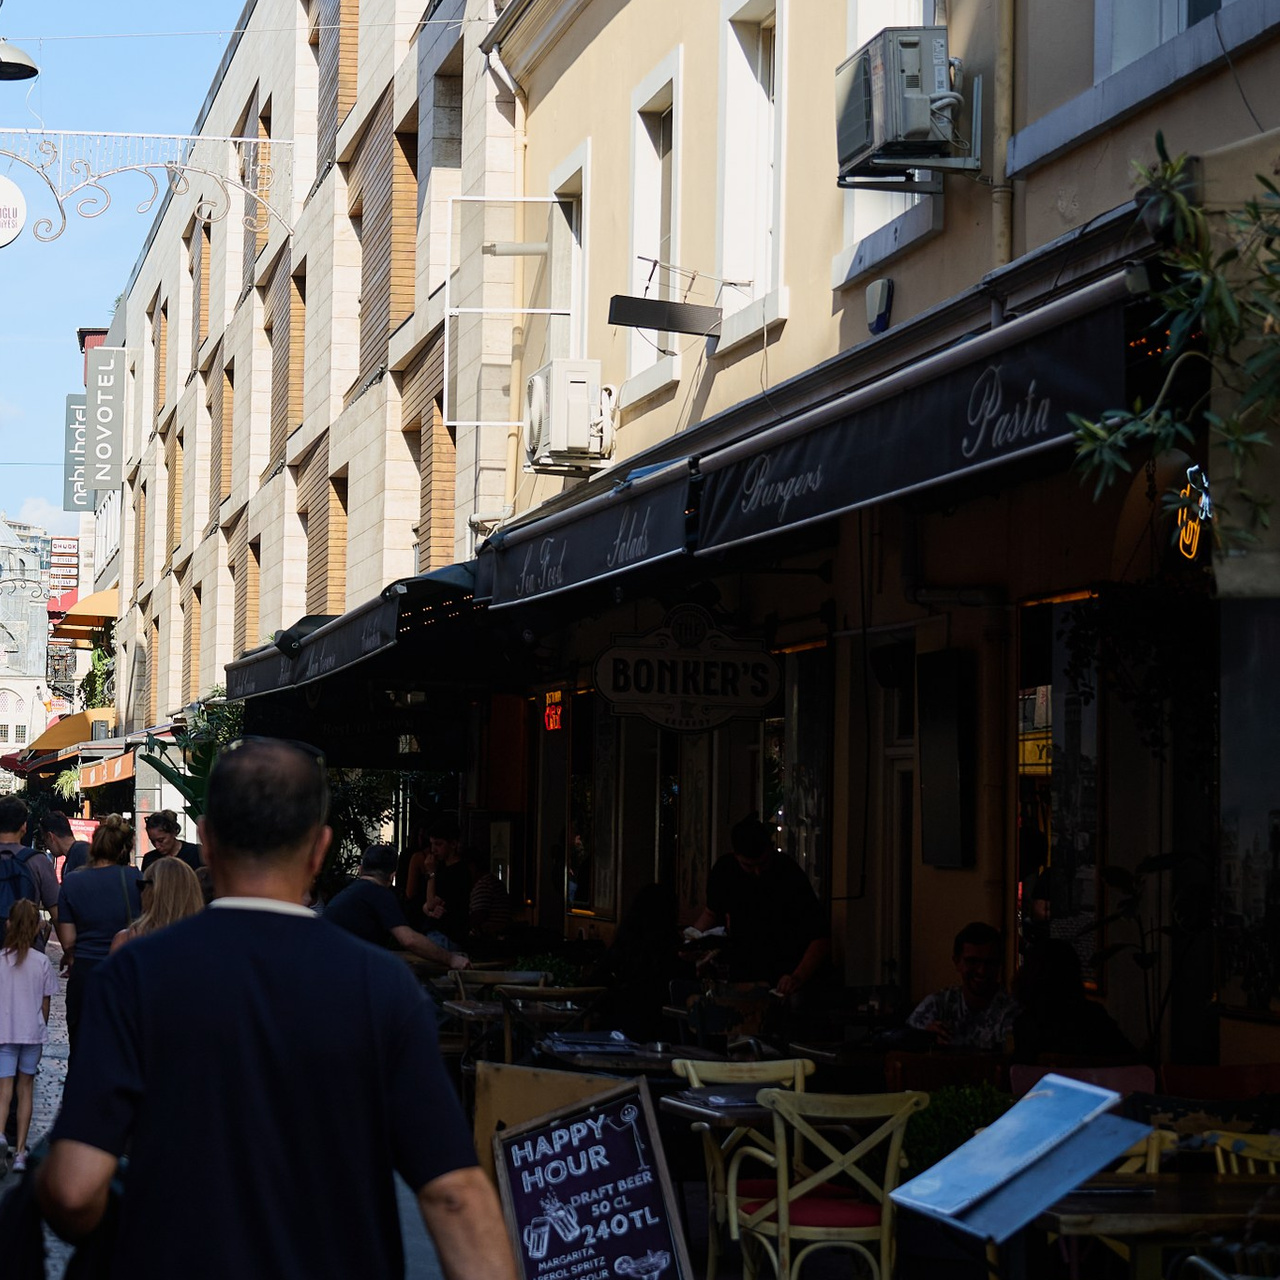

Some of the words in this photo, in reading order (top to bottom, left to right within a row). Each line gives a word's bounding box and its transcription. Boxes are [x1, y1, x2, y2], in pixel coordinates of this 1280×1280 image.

[95, 358, 114, 480] NOVOTEL
[741, 454, 824, 523] Burgers
[962, 364, 1052, 458] Pasta
[538, 537, 567, 590] Food
[607, 505, 651, 567] Salads
[612, 658, 769, 697] BONKER'S
[510, 1113, 608, 1168] HAPPY
[521, 1144, 610, 1194] HOUR
[570, 1183, 615, 1208] DRAFT
[617, 1171, 653, 1193] BEER
[591, 1202, 611, 1218] 50
[613, 1196, 631, 1210] CL
[538, 1247, 596, 1271] MARGARITA
[571, 1256, 606, 1276] SPRITZ
